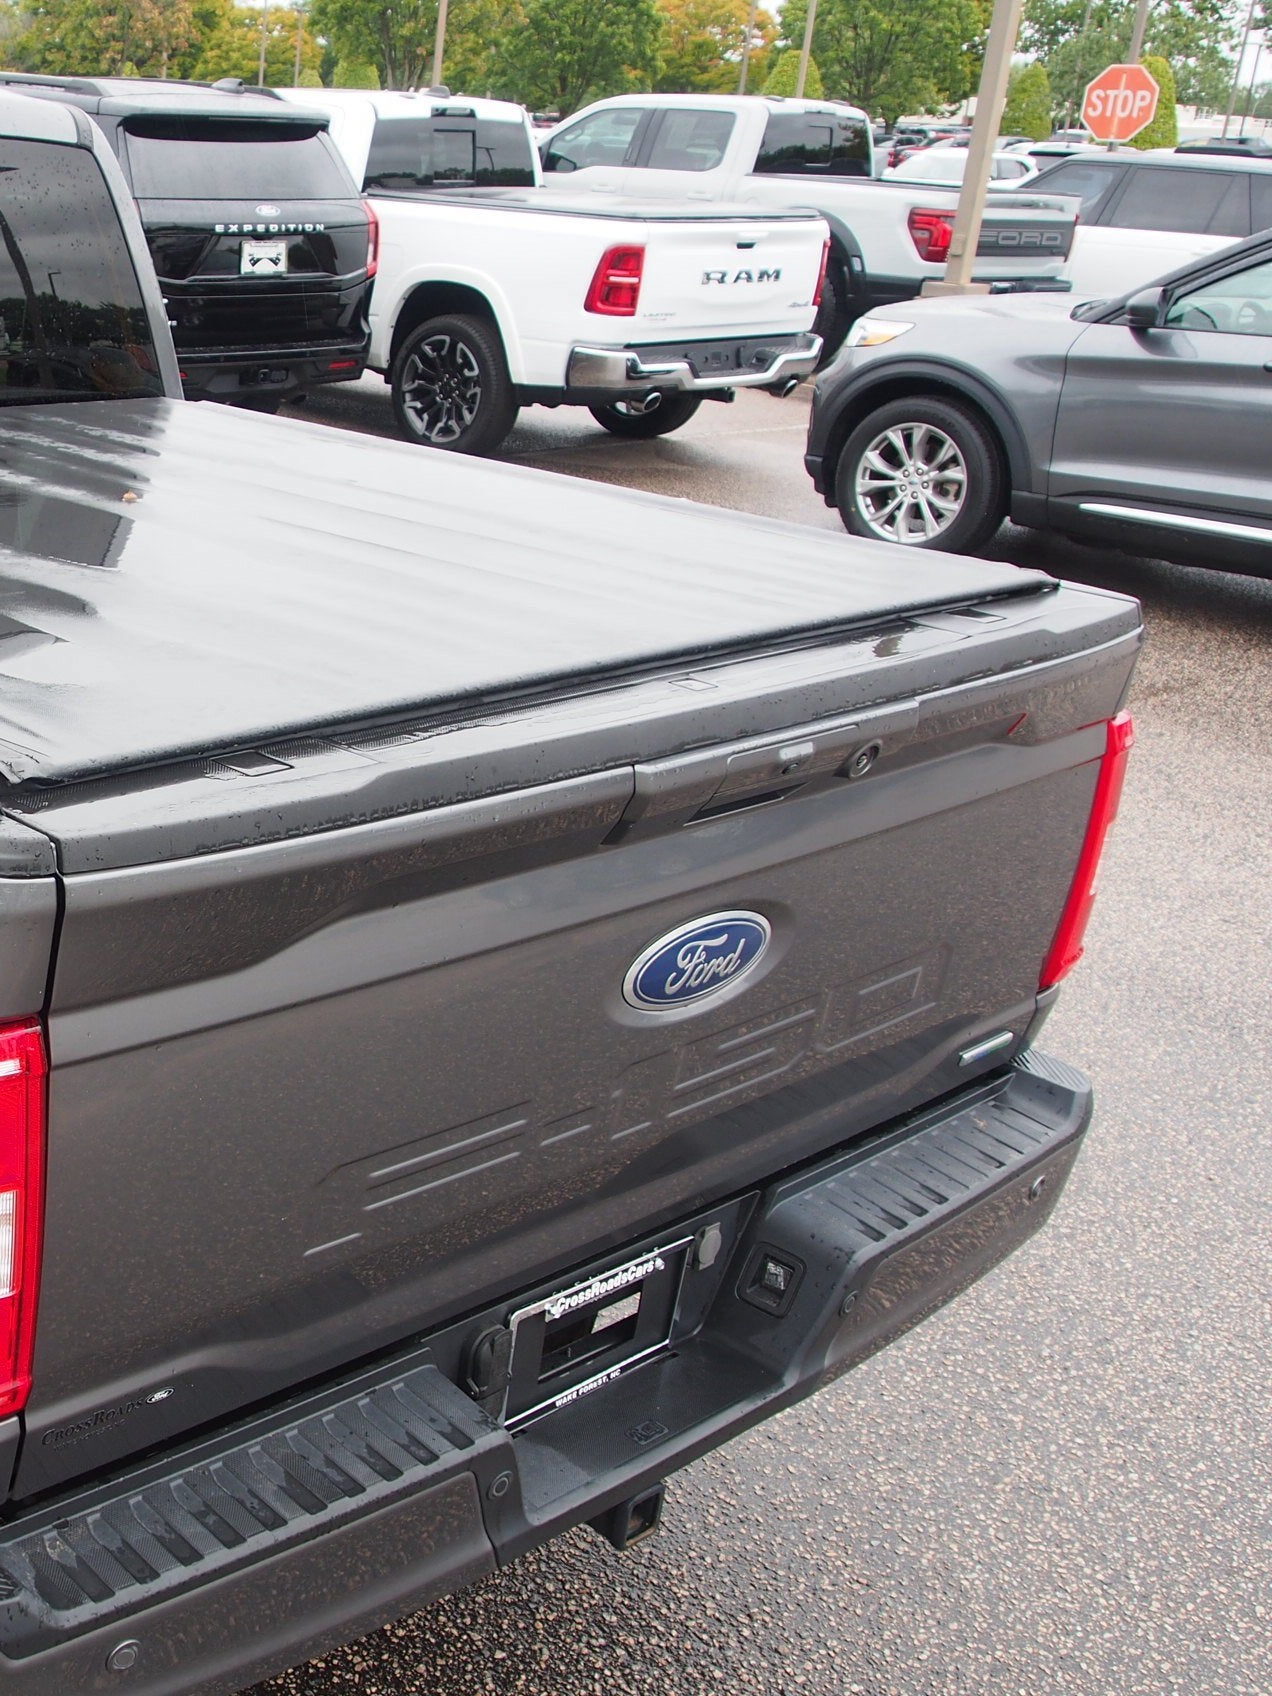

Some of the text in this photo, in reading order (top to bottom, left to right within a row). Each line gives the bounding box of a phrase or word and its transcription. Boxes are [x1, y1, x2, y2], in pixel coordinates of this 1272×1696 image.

[1088, 89, 1151, 118] STOP
[215, 224, 324, 232] EXPEDITION
[701, 269, 781, 285] RAM
[665, 934, 745, 994] Ford
[556, 1369, 621, 1407] WAKE FOREST, NC
